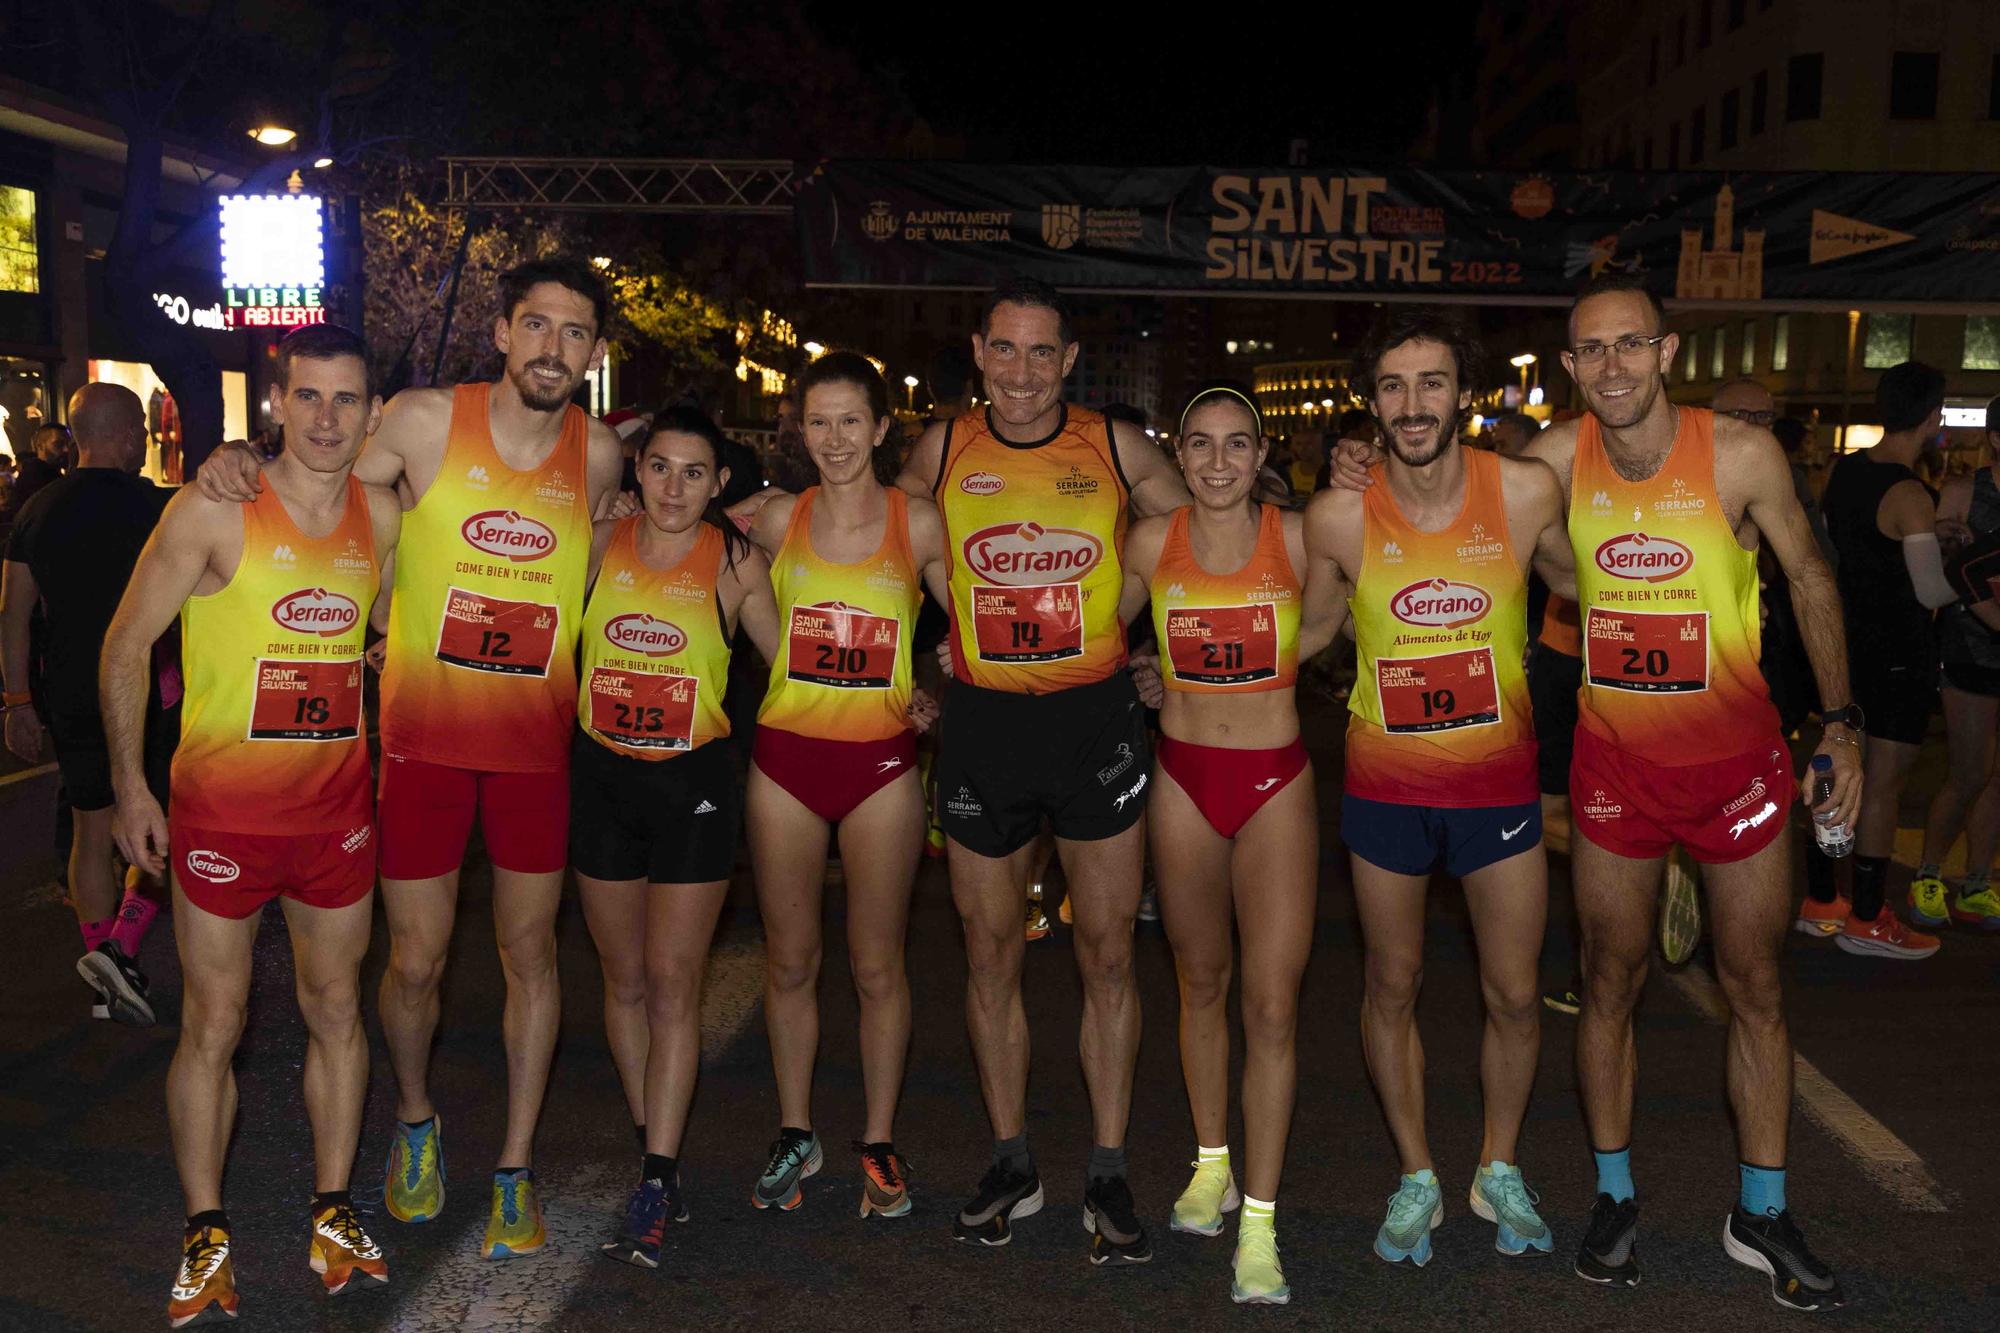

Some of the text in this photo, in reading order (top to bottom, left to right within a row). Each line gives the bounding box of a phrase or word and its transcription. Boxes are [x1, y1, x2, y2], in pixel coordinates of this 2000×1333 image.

[1210, 175, 1388, 235] SANT
[905, 210, 1012, 225] AJUNTAMENT
[905, 227, 925, 241] DE
[1450, 261, 1524, 284] 2022
[227, 288, 321, 307] LIBRE
[963, 479, 1002, 490] Serrano
[1056, 480, 1098, 490] SERRANO
[535, 486, 576, 501] SERRANO
[1654, 499, 1705, 511] SERRANO
[471, 520, 550, 550] Serrano
[976, 541, 1093, 573] Serrano
[1456, 543, 1503, 557] SERRANO
[1604, 547, 1684, 569] Serrano
[334, 558, 371, 569] SERRANO
[455, 561, 554, 585] COME BIEN Y CORRE
[662, 585, 707, 599] SERRANO
[1246, 590, 1292, 601] SERRANO
[1599, 589, 1698, 601] COME BIEN Y CORRE
[451, 598, 486, 615] SANT
[977, 595, 1006, 606] SANT
[1400, 594, 1484, 617] Serrano
[281, 601, 354, 623] Serrano
[795, 615, 826, 629] SANT
[1169, 616, 1200, 628] SANT
[1591, 617, 1624, 631] SANT
[611, 622, 681, 647] Serrano
[1011, 622, 1043, 648] 14
[1393, 630, 1492, 646] Alimentos de Hoy
[267, 643, 357, 655] COME BIEN Y CORRE
[478, 630, 512, 657] 12
[815, 644, 868, 674] 210
[1201, 642, 1243, 670] 211
[1621, 647, 1669, 677] 20
[262, 668, 298, 681] SANT
[603, 658, 686, 676] COME BIEN Y CORRE
[1381, 666, 1413, 679] SANT
[593, 674, 625, 688] SANT
[294, 697, 330, 725] 18
[1421, 689, 1456, 718] 19
[614, 703, 665, 732] 213
[1098, 754, 1134, 785] Paterna
[947, 800, 983, 812] SERRANO
[1584, 805, 1622, 814] SERRANO
[191, 855, 236, 877] Serrano
